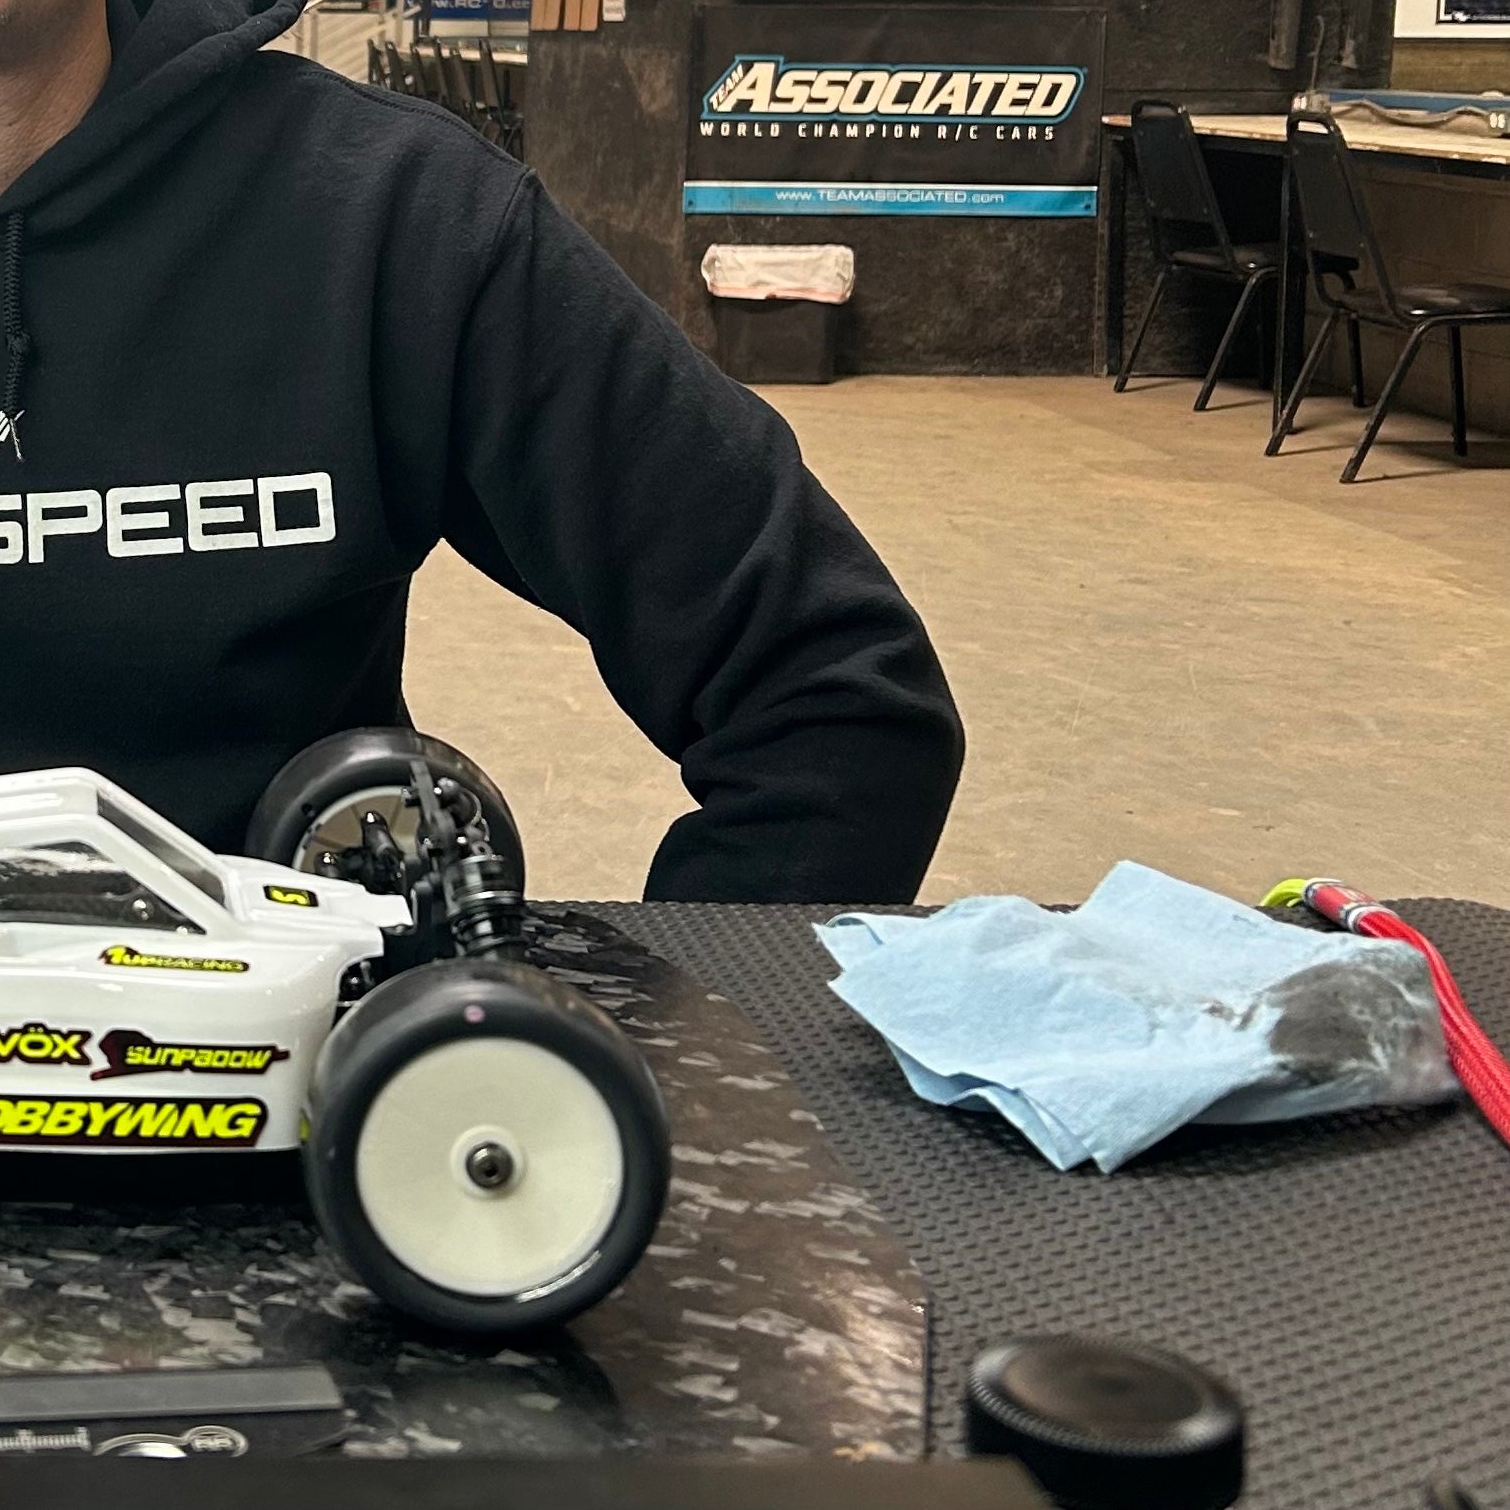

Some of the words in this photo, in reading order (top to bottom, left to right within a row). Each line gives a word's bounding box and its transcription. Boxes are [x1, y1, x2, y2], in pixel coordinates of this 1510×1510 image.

[708, 63, 745, 113] TEAM
[717, 61, 1077, 117] ASSOCIATED
[699, 121, 781, 138] WORLD
[797, 122, 921, 140] CHAMPION
[937, 124, 979, 142] R/C
[995, 125, 1056, 142] CARS
[775, 189, 1005, 204] www.TEAMASSOCIATED.com
